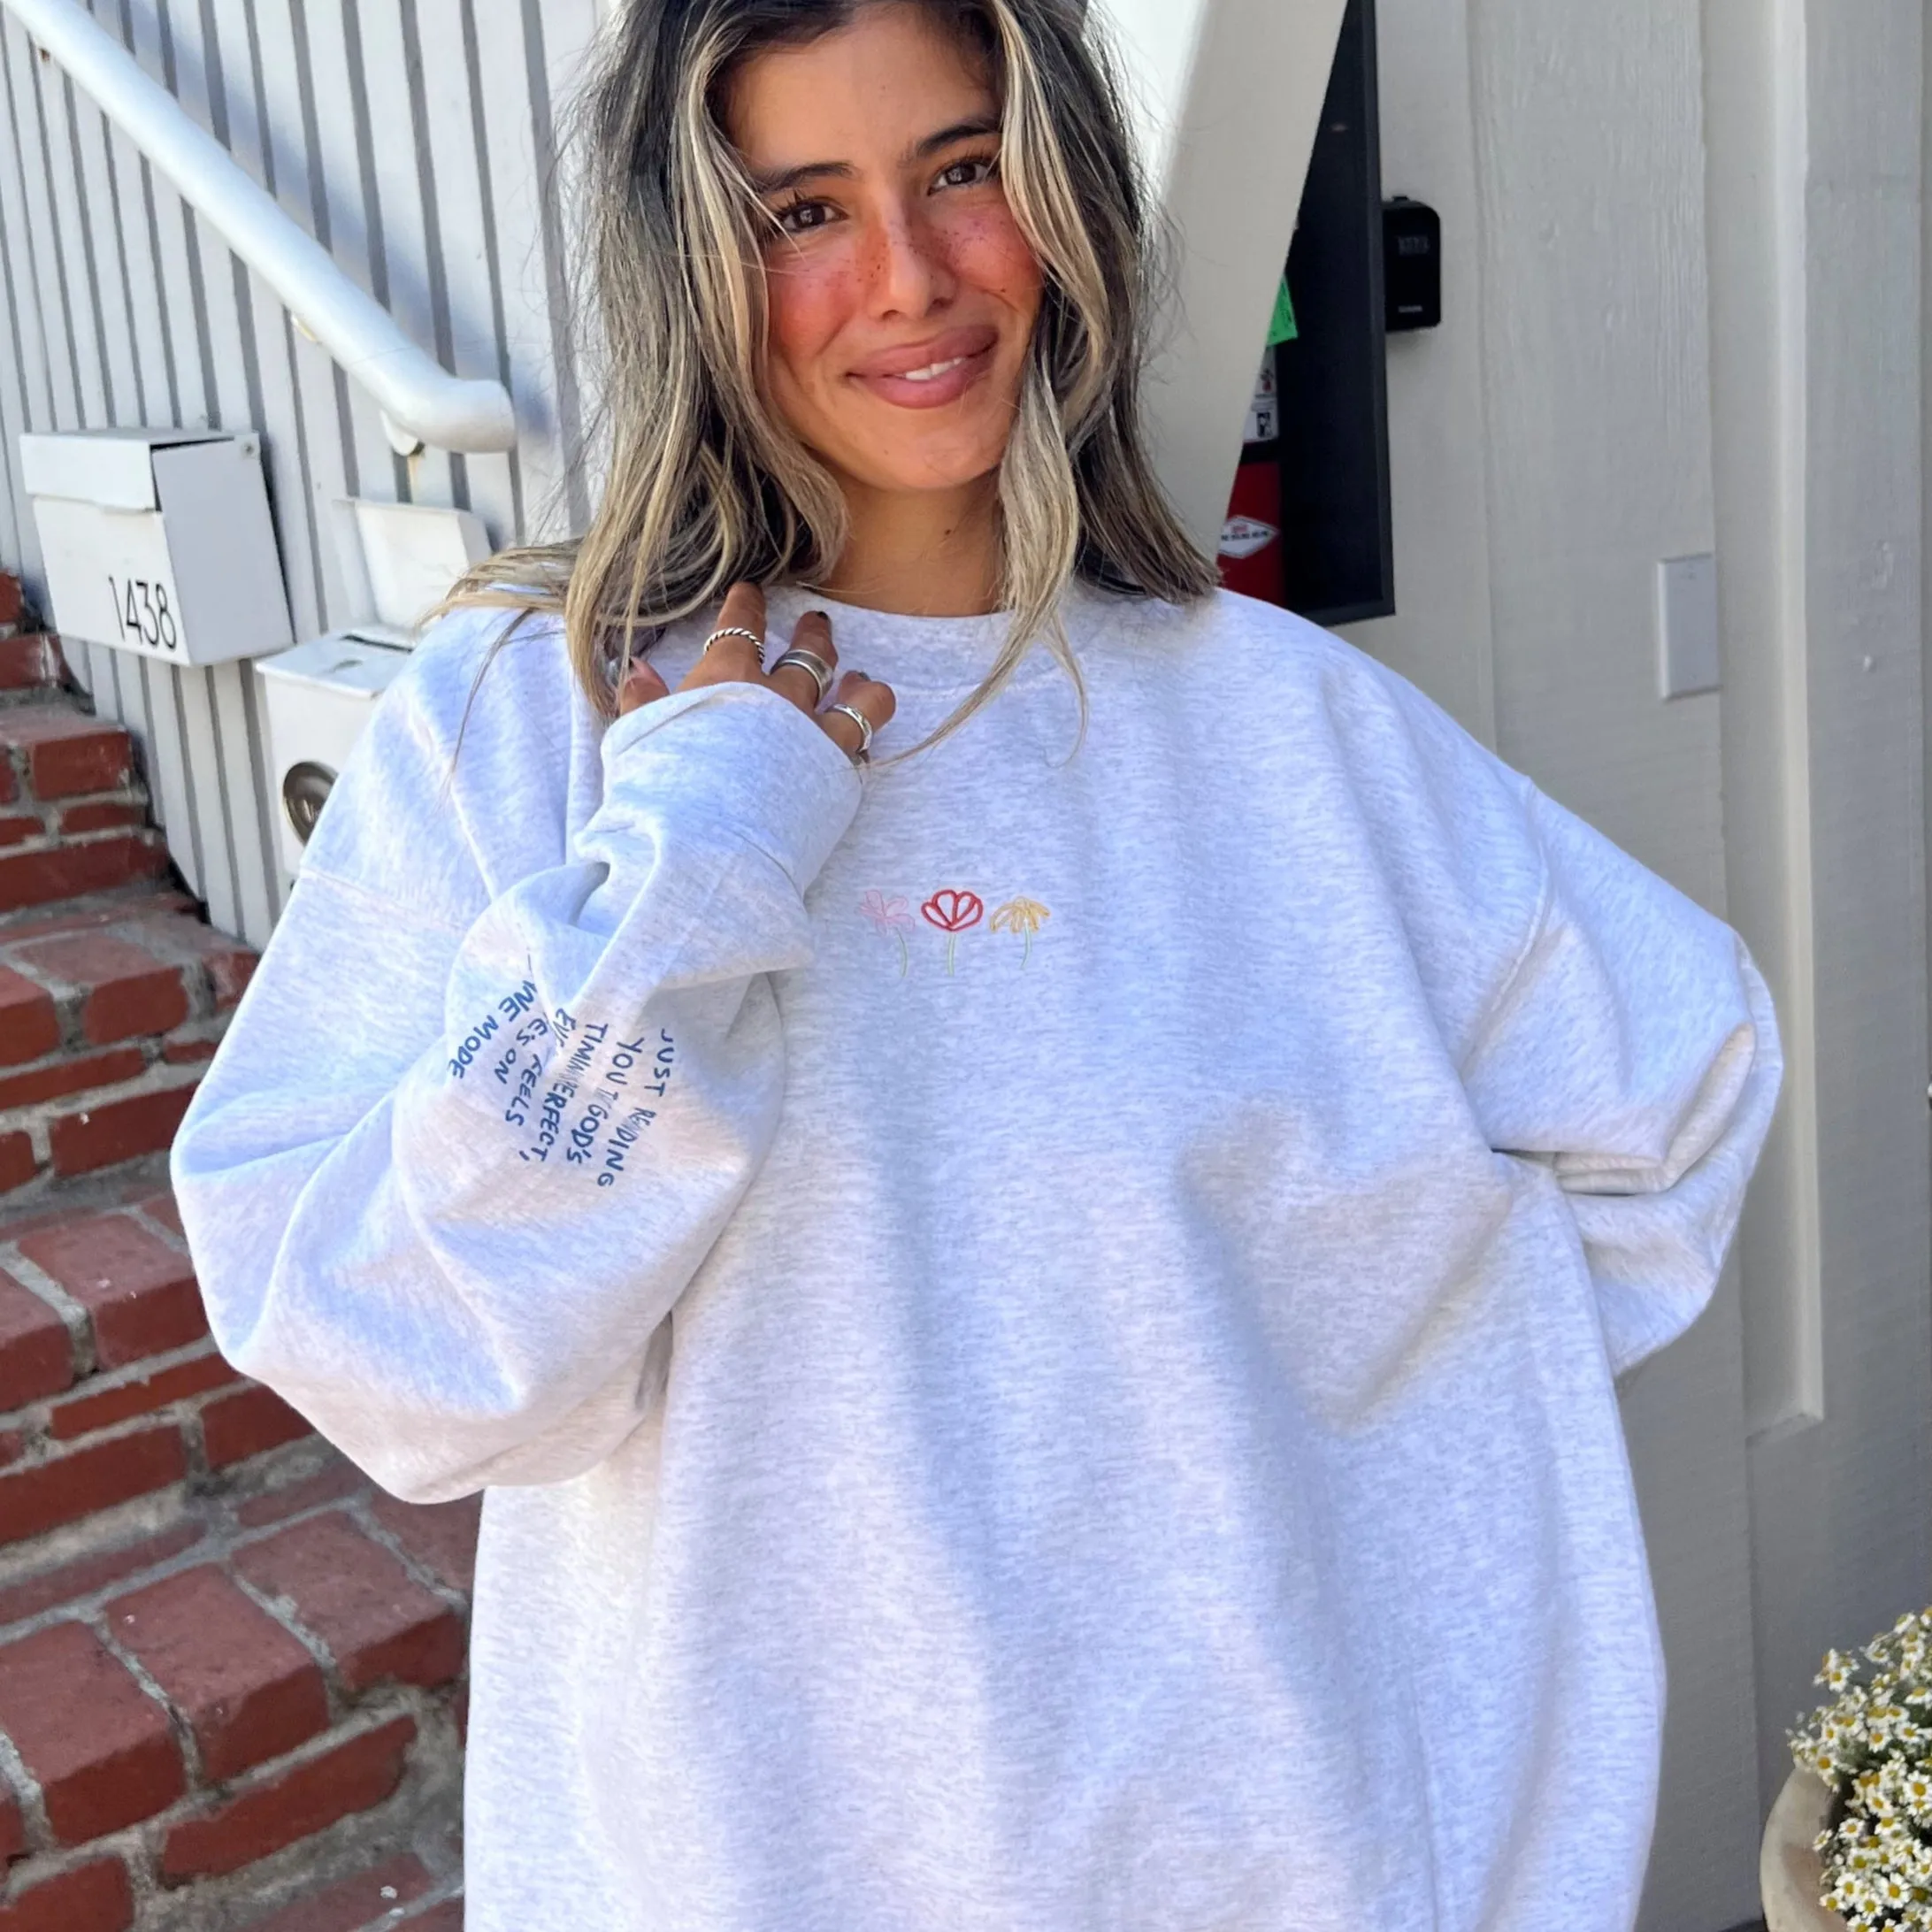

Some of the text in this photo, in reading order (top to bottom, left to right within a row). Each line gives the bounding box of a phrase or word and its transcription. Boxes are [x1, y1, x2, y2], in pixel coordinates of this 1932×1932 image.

[108, 575, 177, 651] 1438
[448, 1015, 499, 1079] MODE
[494, 1048, 517, 1085] ON
[605, 1037, 645, 1085] YOU
[644, 1028, 675, 1097] JUST
[566, 1103, 610, 1164] GOD'S
